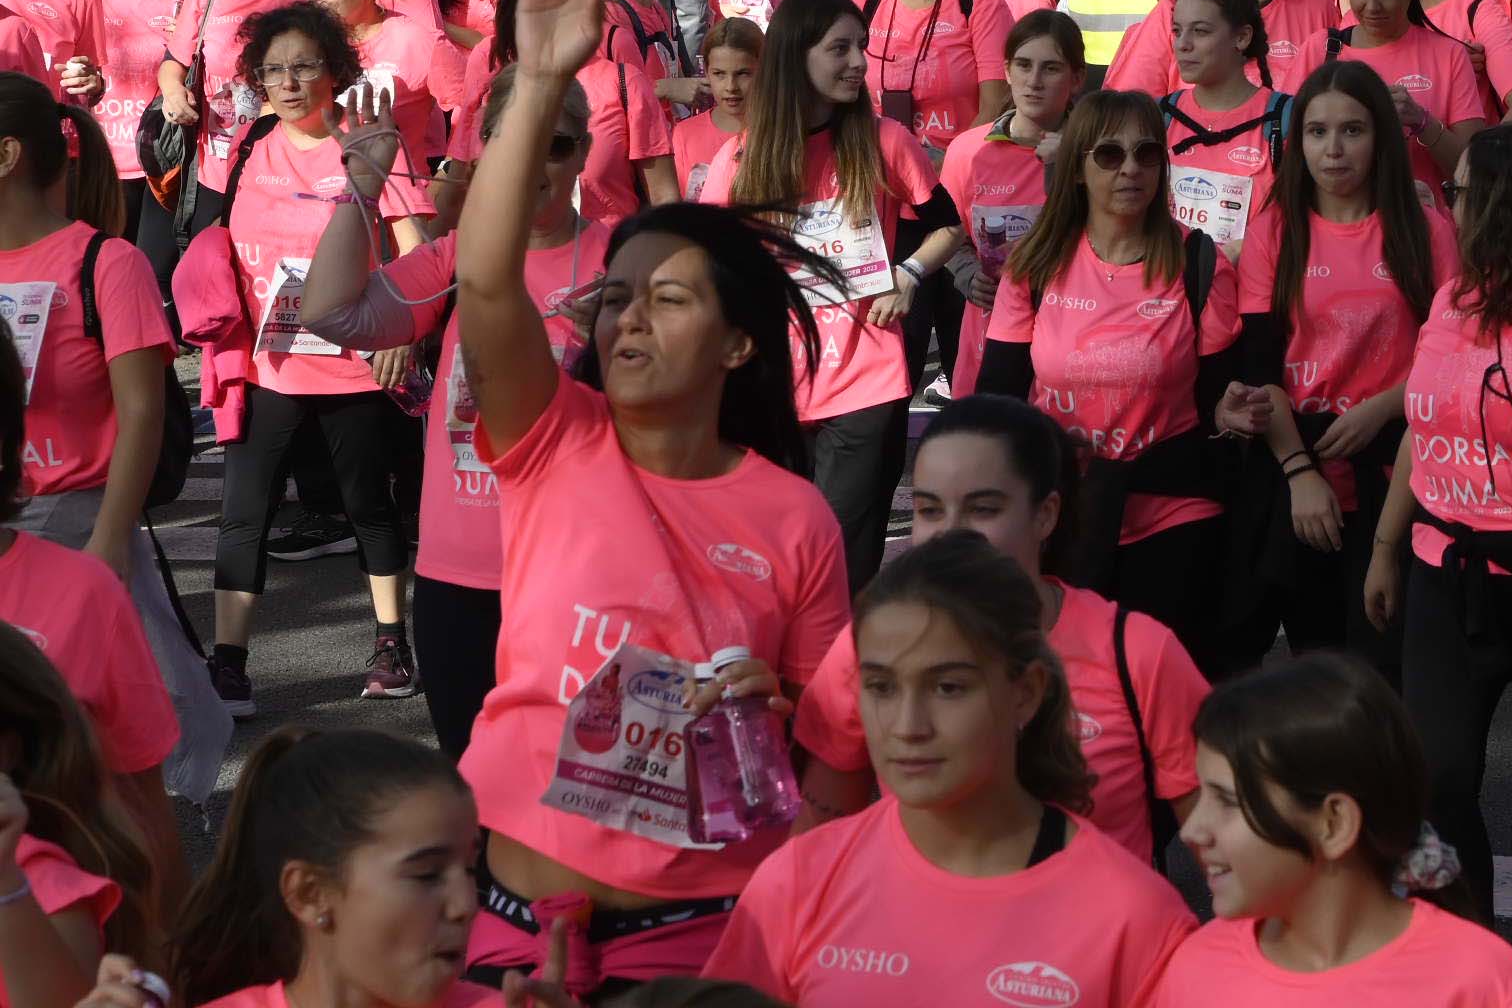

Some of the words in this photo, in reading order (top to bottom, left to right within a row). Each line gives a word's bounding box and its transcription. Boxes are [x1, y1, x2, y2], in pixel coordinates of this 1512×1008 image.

[1178, 205, 1208, 223] 016
[1045, 293, 1097, 312] OYSHO
[1408, 392, 1434, 422] TU
[570, 603, 629, 658] TU
[630, 680, 685, 708] ASTURIA
[625, 722, 683, 756] 016
[624, 755, 669, 780] 27494
[818, 944, 909, 978] OYSHO
[995, 971, 1072, 1005] ASTURIANA
